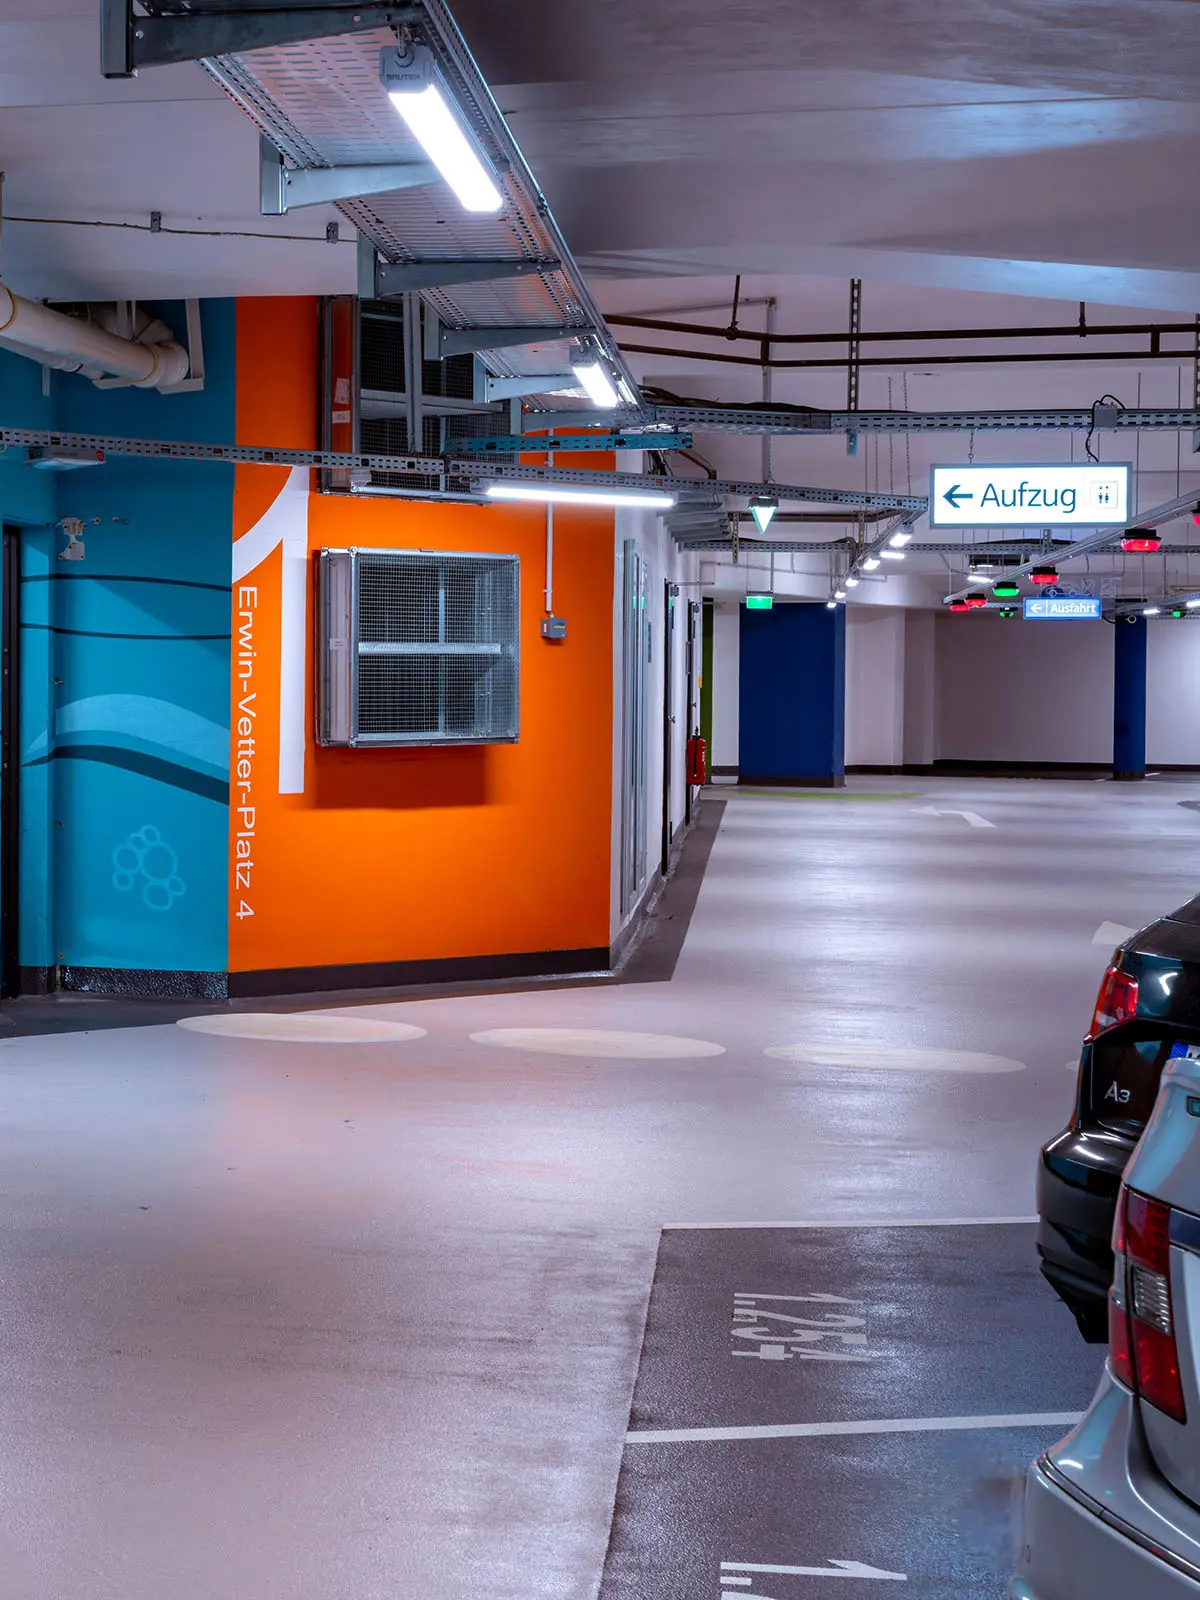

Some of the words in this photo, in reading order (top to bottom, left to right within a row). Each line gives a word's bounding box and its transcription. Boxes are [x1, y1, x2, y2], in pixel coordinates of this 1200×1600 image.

[980, 481, 1077, 514] Aufzug
[1050, 602, 1097, 614] Ausfahrt
[232, 466, 309, 793] 1
[236, 586, 258, 889] Erwin-Vetter-Platz
[235, 900, 255, 921] 4
[1103, 1080, 1131, 1104] A3
[730, 1292, 872, 1362] 1.254
[720, 1558, 908, 1600] 1.
